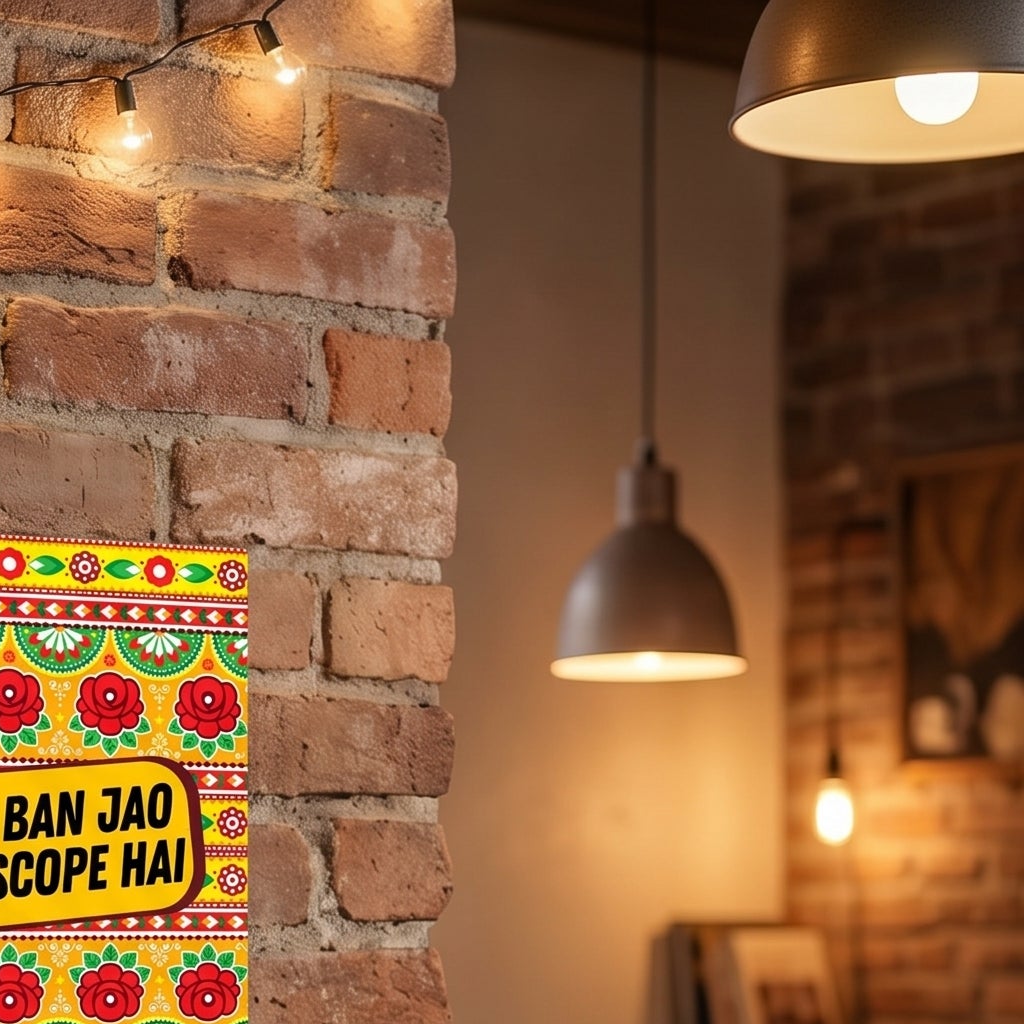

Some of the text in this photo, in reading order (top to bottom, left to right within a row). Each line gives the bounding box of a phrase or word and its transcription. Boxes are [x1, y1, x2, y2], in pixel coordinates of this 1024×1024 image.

[3, 788, 86, 842] BAN
[97, 782, 173, 833] JAO
[121, 837, 186, 888] HAI
